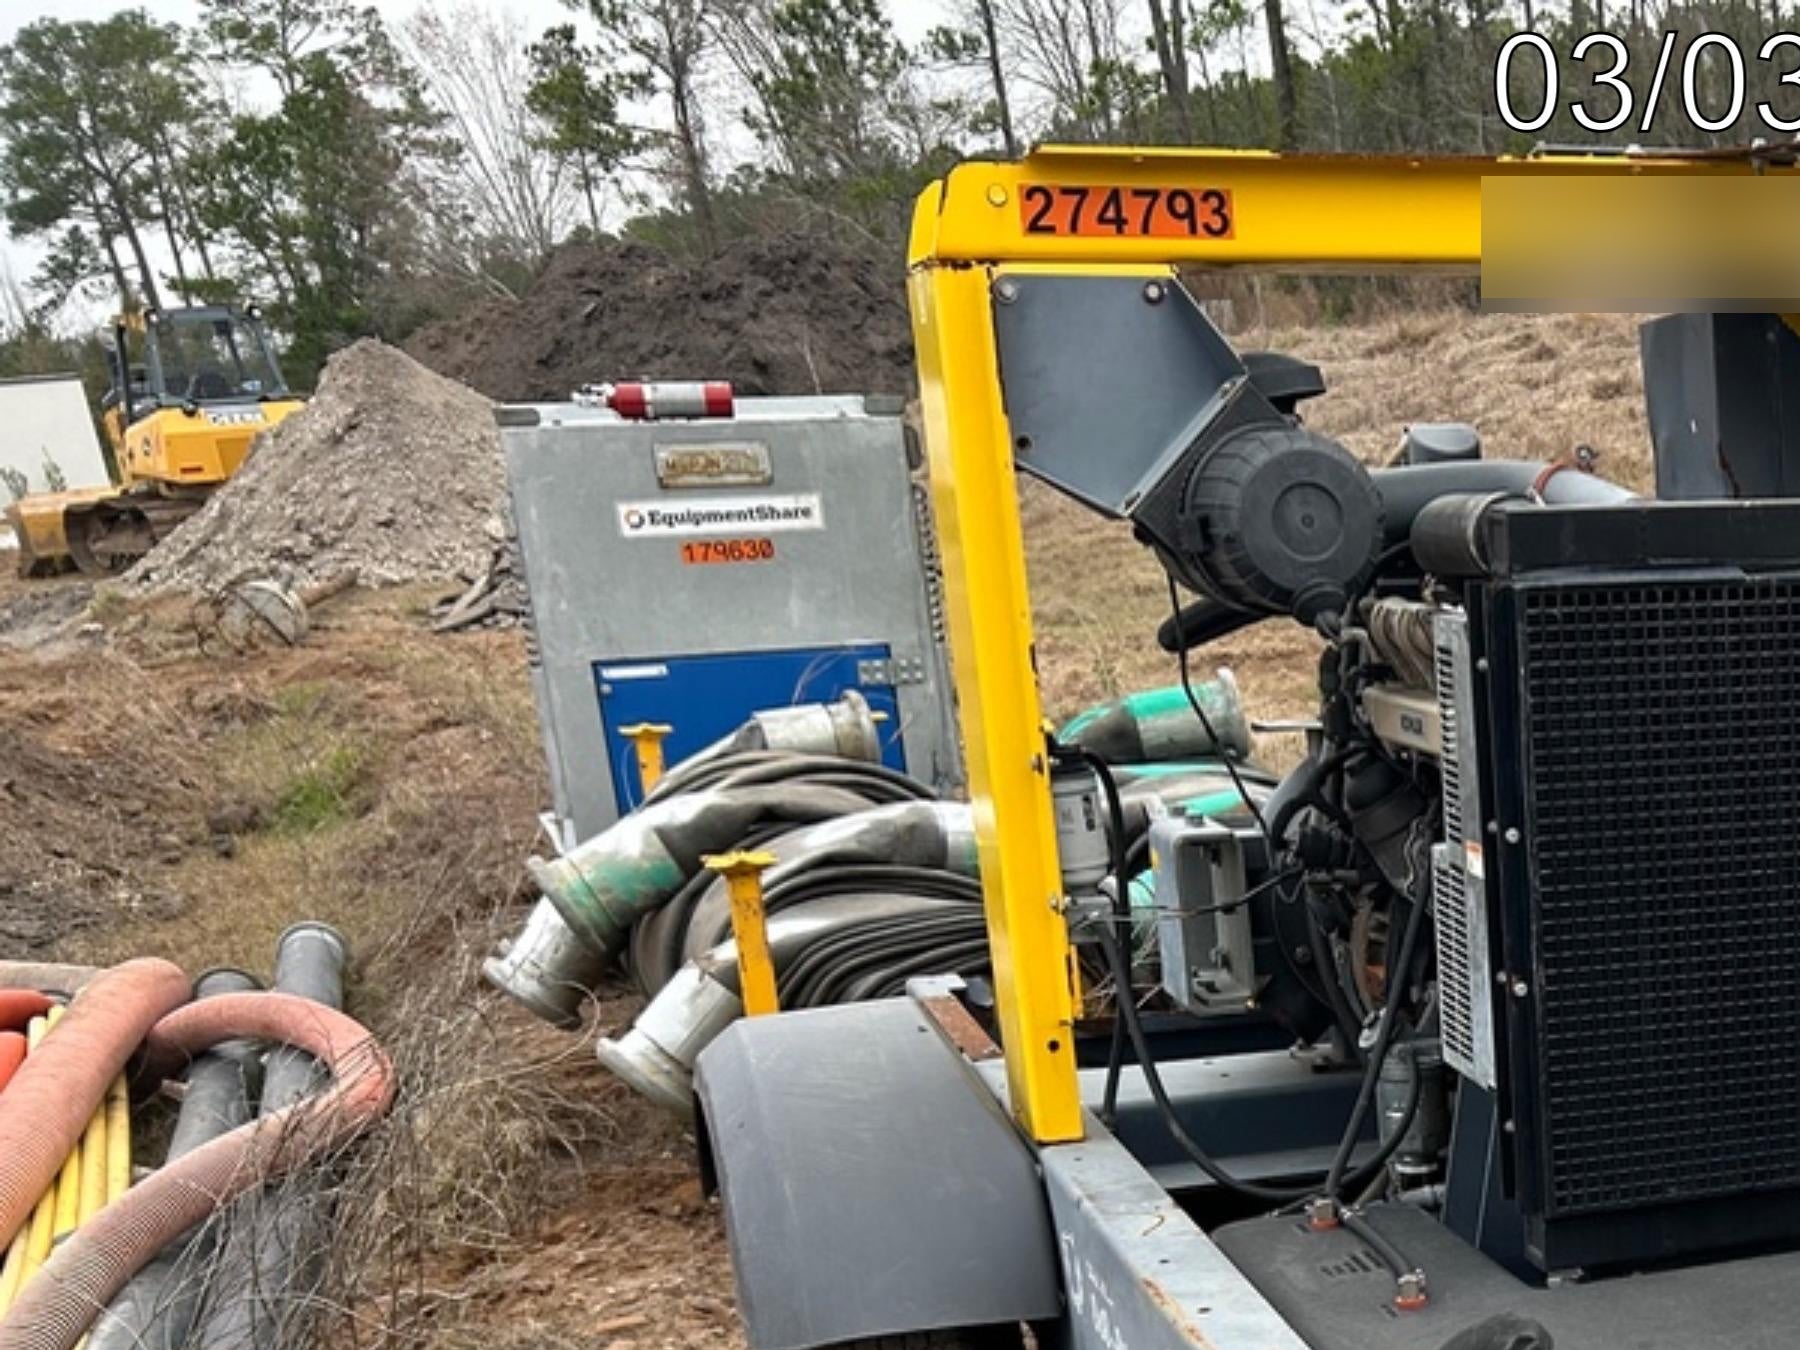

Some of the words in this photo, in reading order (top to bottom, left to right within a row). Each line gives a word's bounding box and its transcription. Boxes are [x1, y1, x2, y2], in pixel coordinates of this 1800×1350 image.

[1024, 185, 1230, 237] 274793
[648, 504, 812, 528] EquipmentShare
[683, 538, 775, 563] 179630
